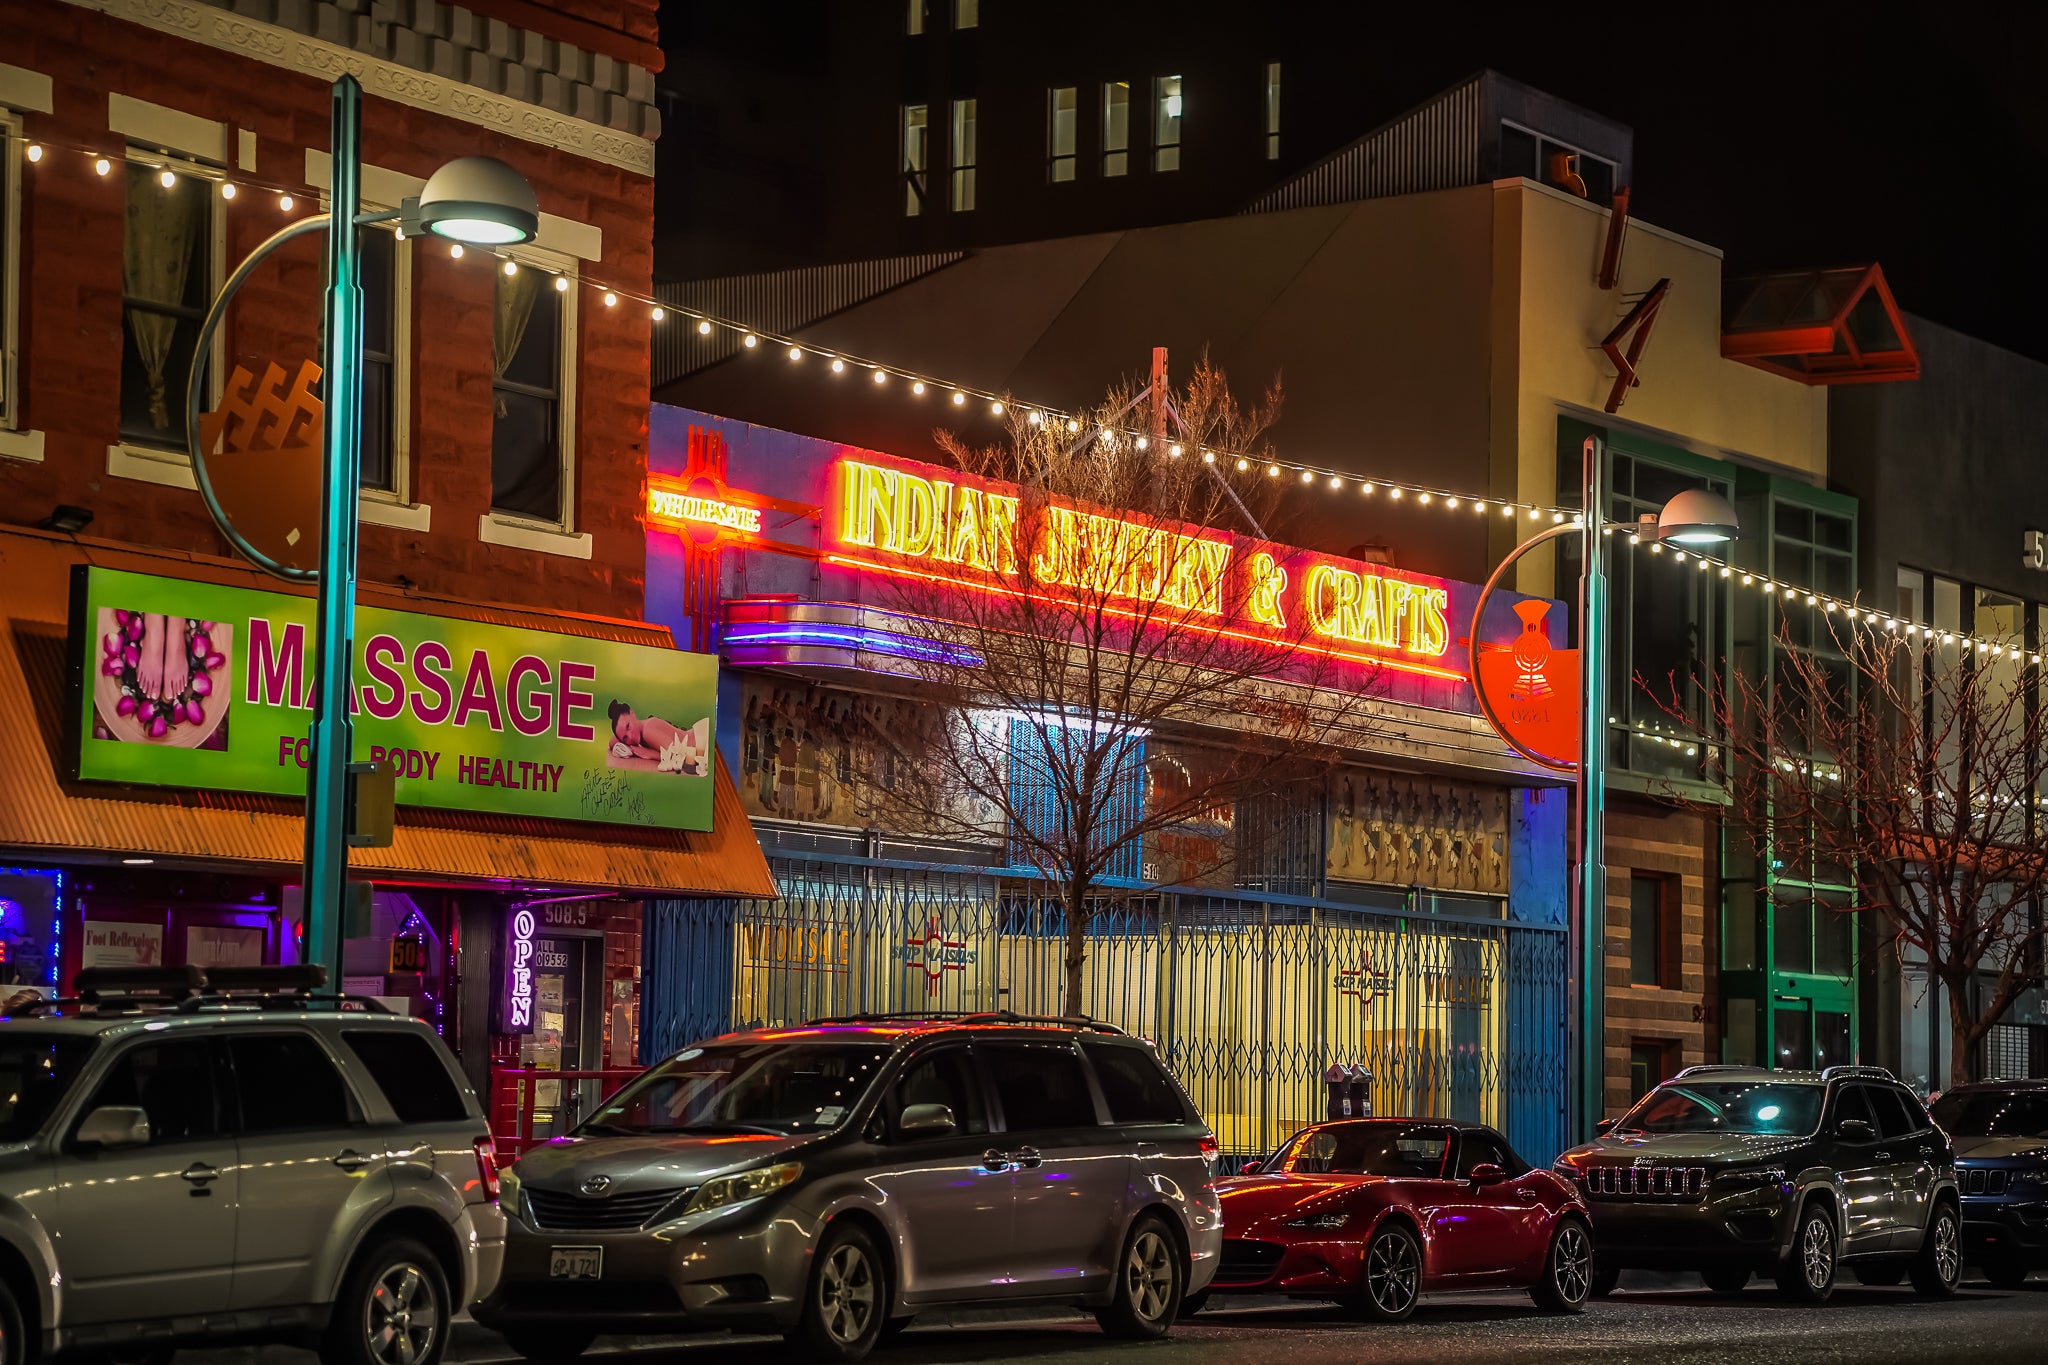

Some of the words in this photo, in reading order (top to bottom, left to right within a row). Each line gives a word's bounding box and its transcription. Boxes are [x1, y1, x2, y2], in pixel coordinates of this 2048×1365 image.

[649, 488, 762, 533] WHOLESALE
[841, 461, 1020, 575] INDIAN
[1037, 506, 1234, 615] JEWELRY
[1250, 552, 1288, 629] &
[1307, 565, 1450, 657] CRAFTS
[279, 736, 309, 768] FO
[370, 746, 440, 781] BODY
[458, 754, 564, 793] HEALTHY
[1144, 864, 1159, 879] 510
[546, 904, 587, 925] 508.5
[86, 930, 106, 946] Foot
[110, 931, 159, 952] Reflexology
[511, 910, 535, 1026] OPEN
[1333, 975, 1355, 988] SKIP
